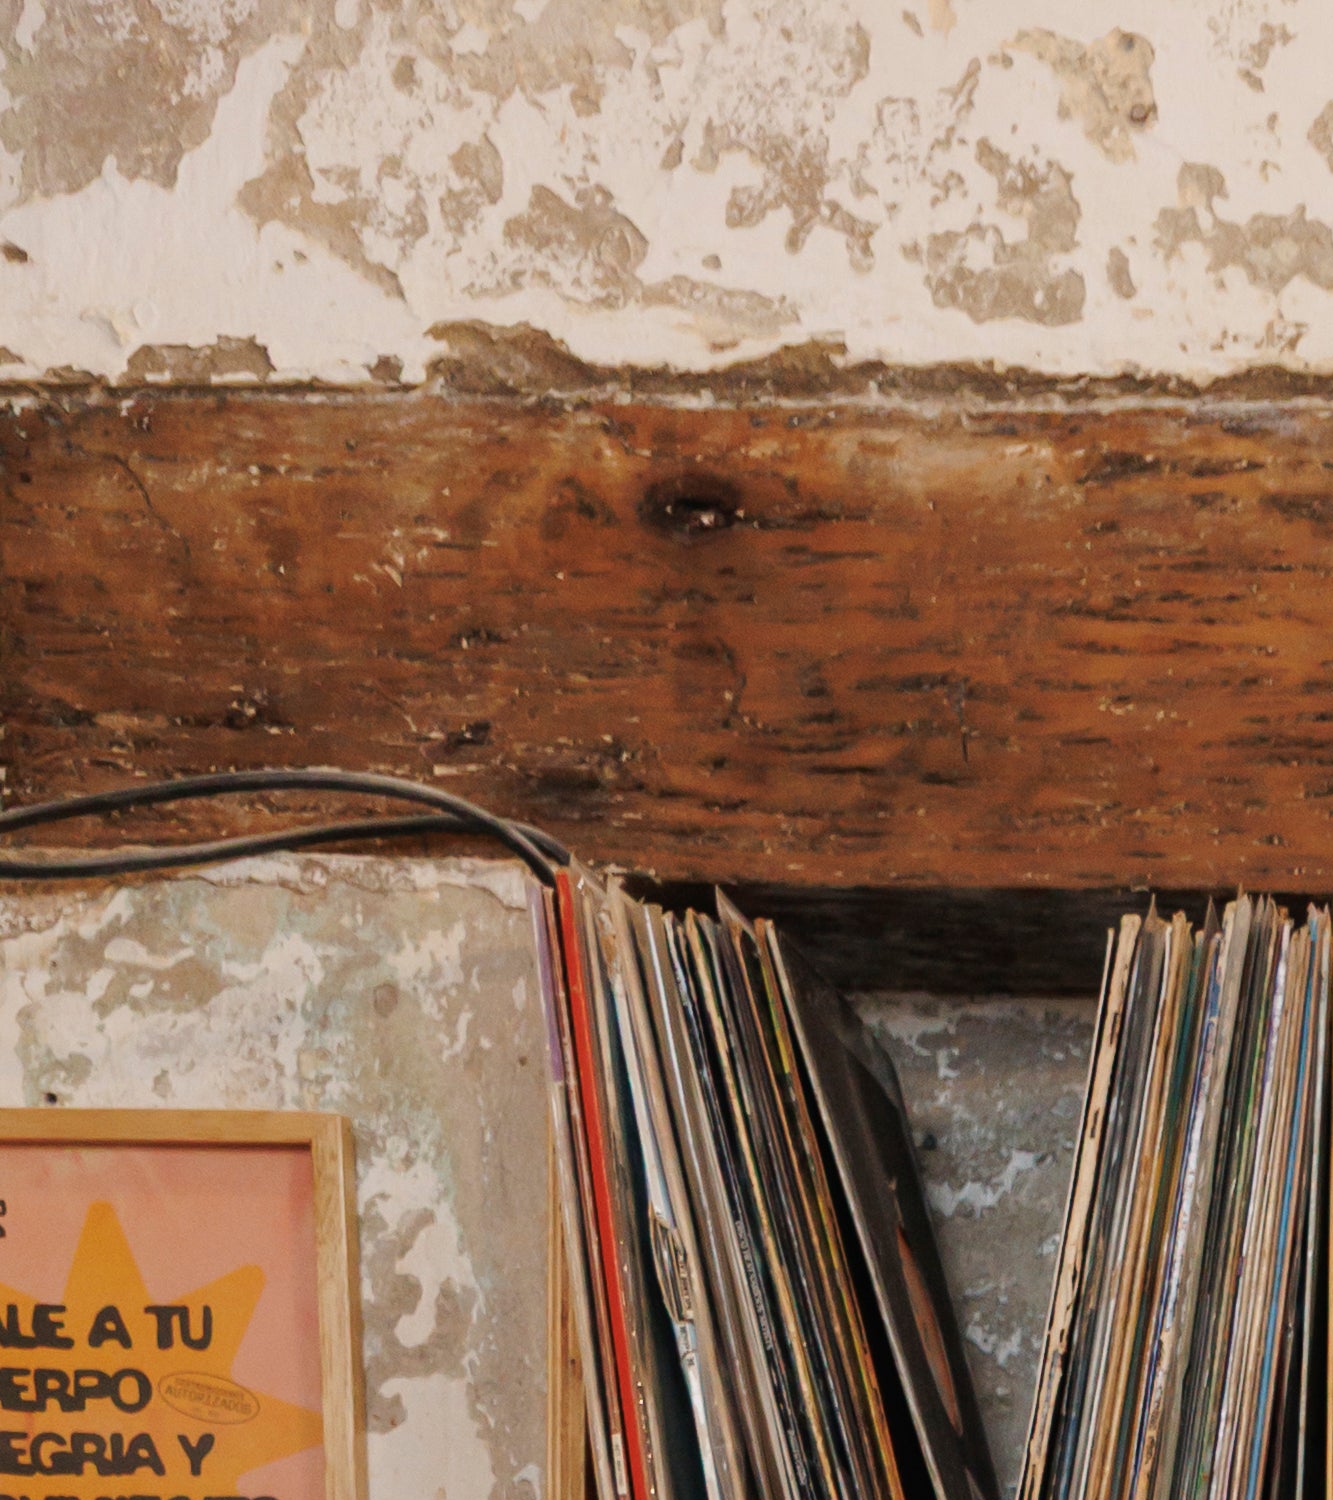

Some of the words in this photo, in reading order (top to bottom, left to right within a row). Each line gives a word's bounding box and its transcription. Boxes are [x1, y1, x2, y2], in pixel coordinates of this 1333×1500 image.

[0, 1303, 75, 1350] LE
[88, 1305, 132, 1349] A
[144, 1304, 213, 1351] TU
[177, 1433, 215, 1477] Y
